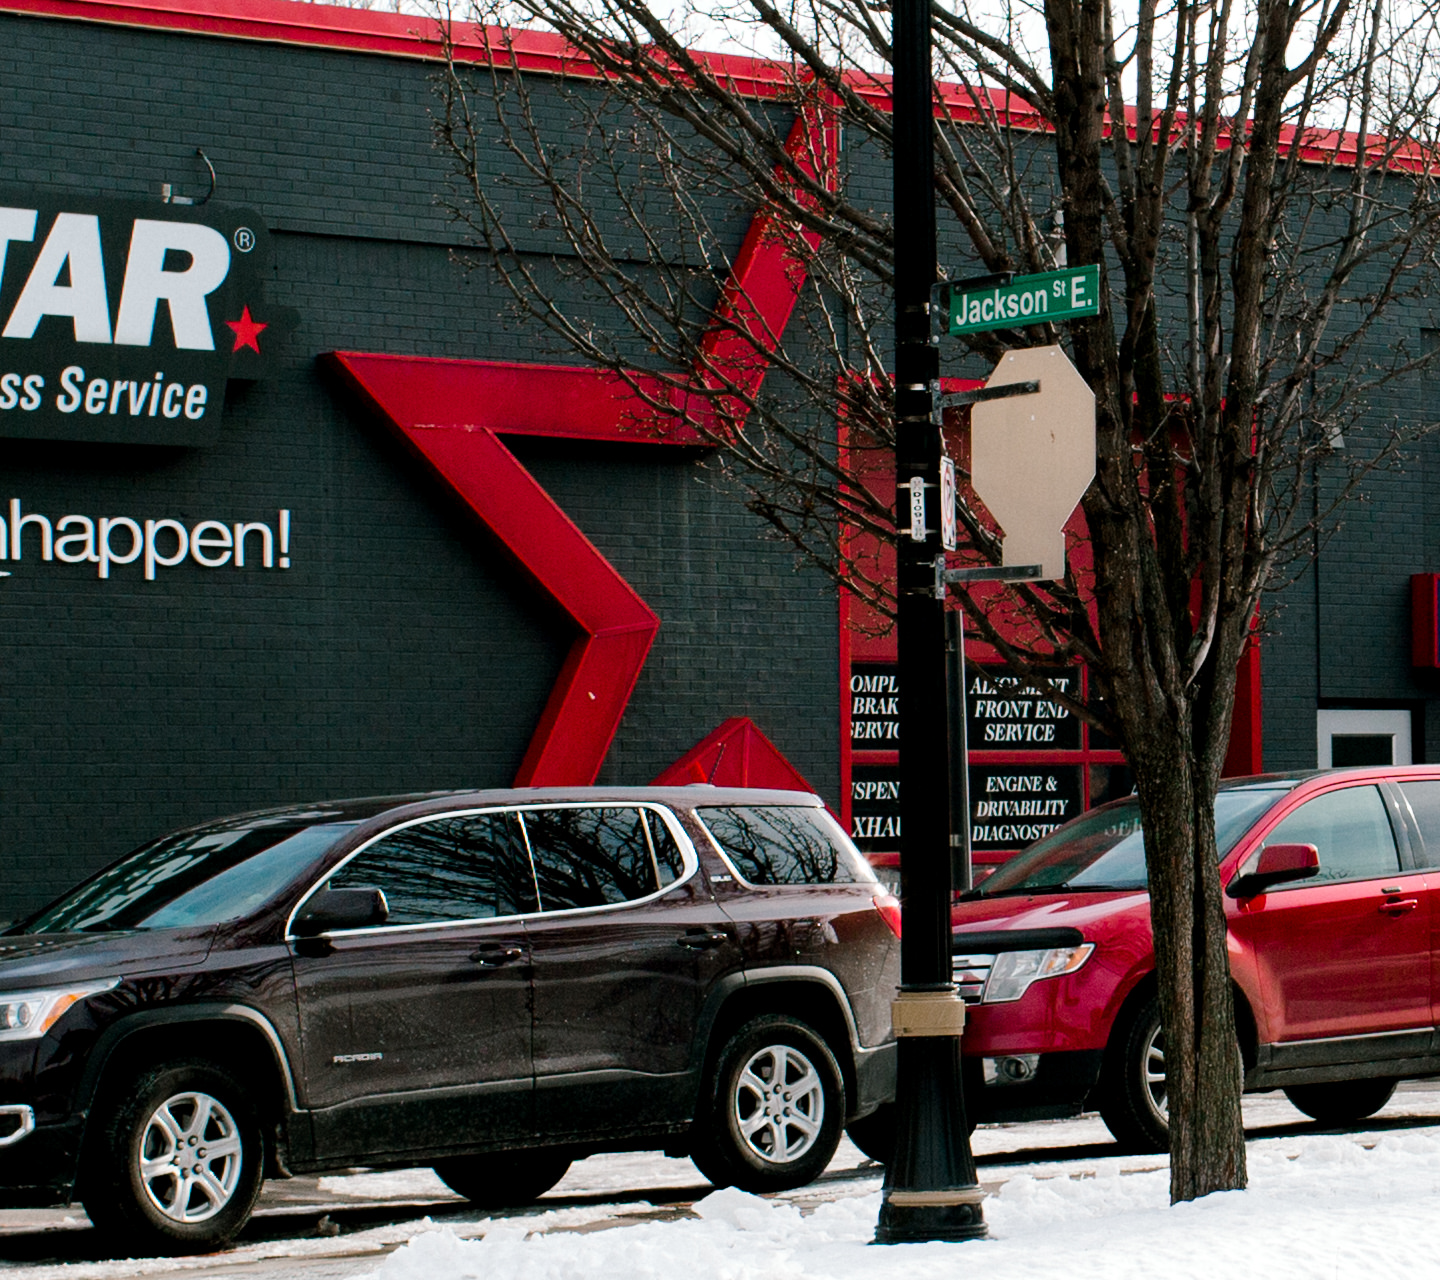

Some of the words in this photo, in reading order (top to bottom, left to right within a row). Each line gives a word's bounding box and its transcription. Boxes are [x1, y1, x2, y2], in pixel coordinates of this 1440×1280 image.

[955, 289, 1047, 325] Jackson
[1053, 280, 1066, 297] St
[1071, 276, 1092, 308] E.
[57, 366, 208, 420] Service
[852, 696, 899, 715] BRAK
[974, 700, 1032, 718] FRONT
[1035, 700, 1069, 719] END
[984, 723, 1055, 742] SERVICE
[985, 775, 1043, 793] ENGINE
[1045, 775, 1058, 792] &
[976, 800, 1069, 817] DRIVABILITY
